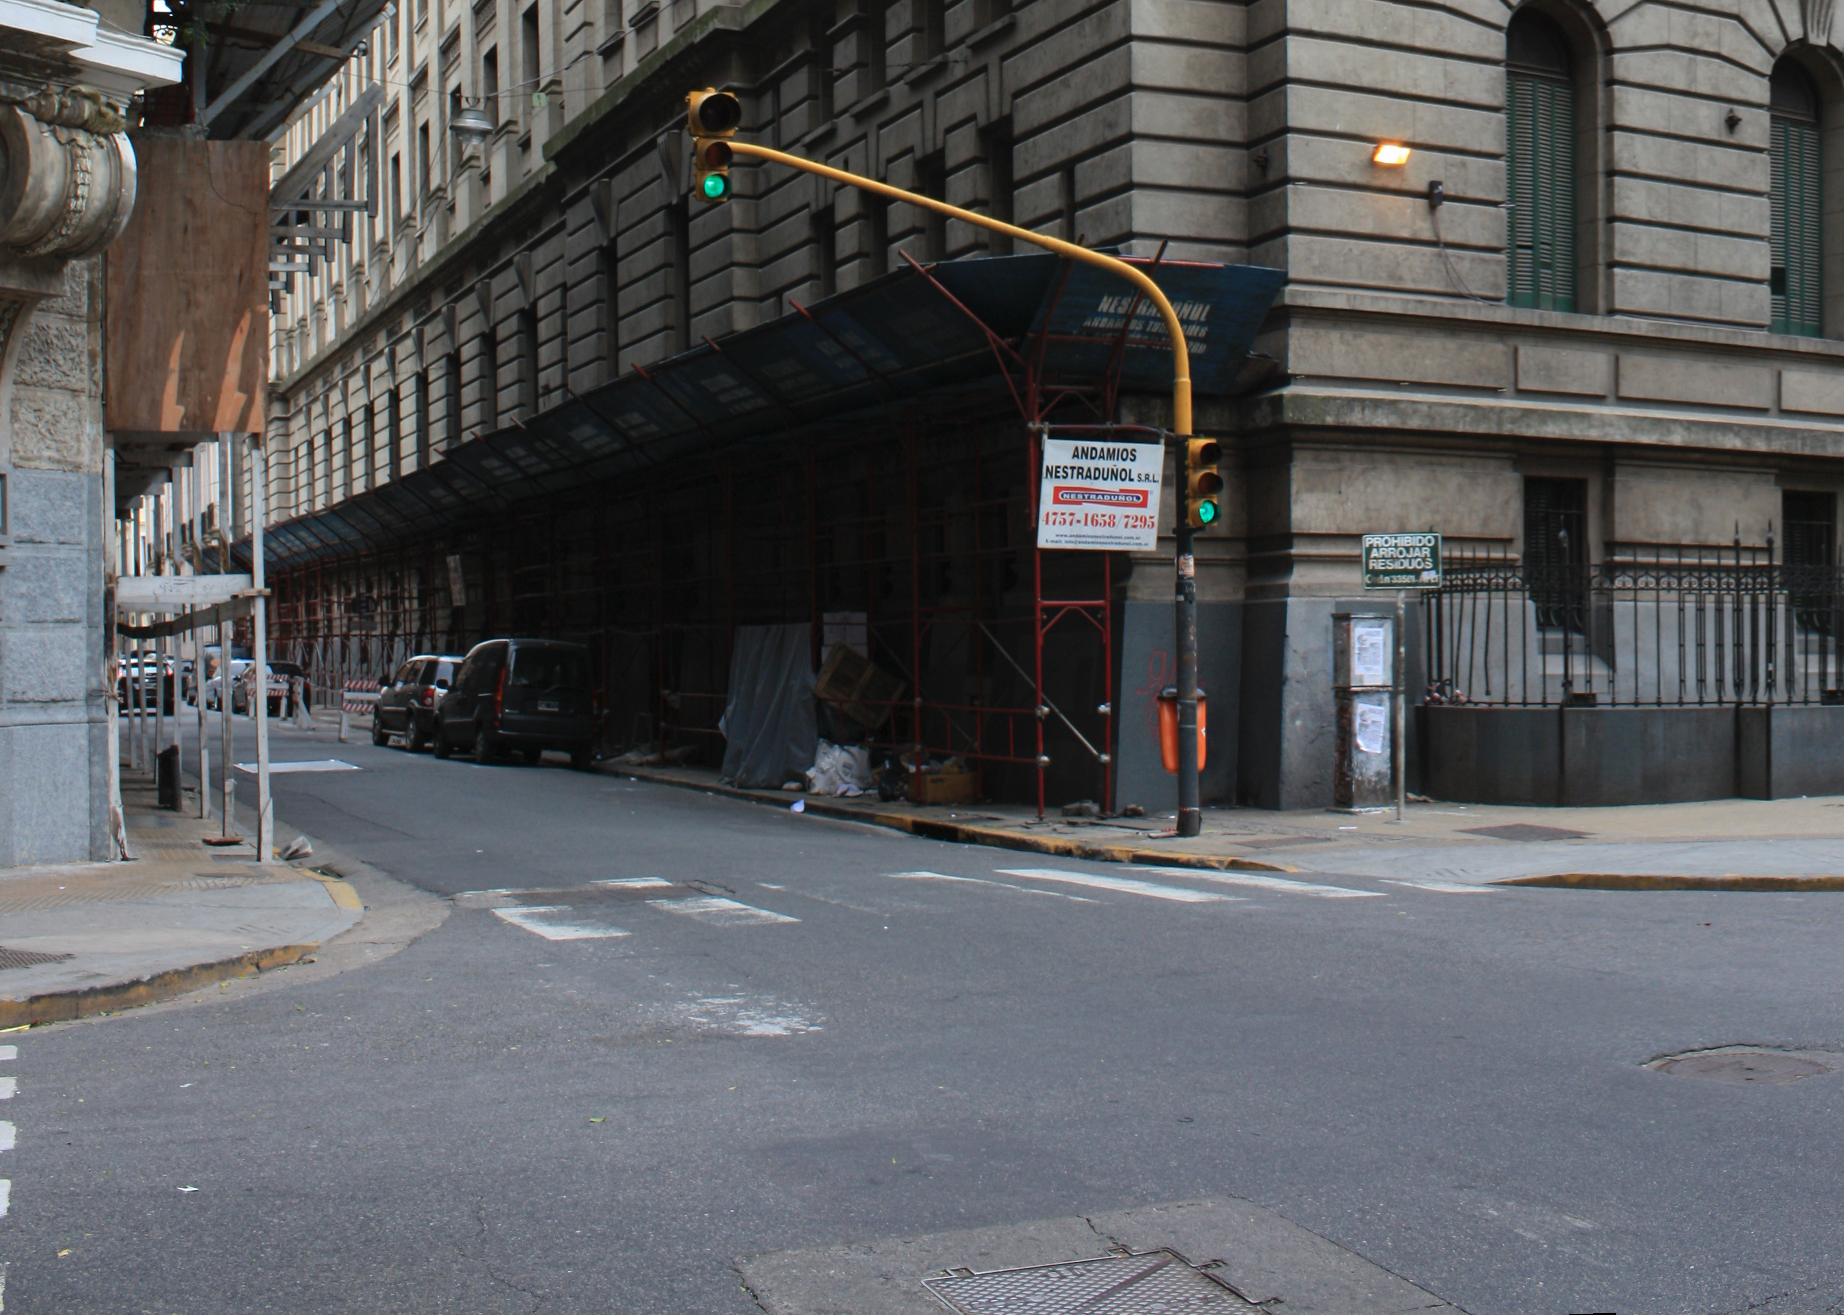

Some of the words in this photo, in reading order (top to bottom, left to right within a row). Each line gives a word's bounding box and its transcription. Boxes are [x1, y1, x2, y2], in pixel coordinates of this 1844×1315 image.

[1072, 446, 1137, 462] ANDAMIOS
[1045, 464, 1135, 482] NESTRADUÑOL
[1137, 473, 1159, 483] S.R.L.
[1062, 492, 1139, 502] NESTRADUÑOL
[1042, 511, 1155, 529] 4757-1658/7295
[1365, 535, 1435, 547] PROHIBIDO
[1370, 547, 1431, 558] ARROJAR
[1369, 558, 1433, 570] RESIDUOS
